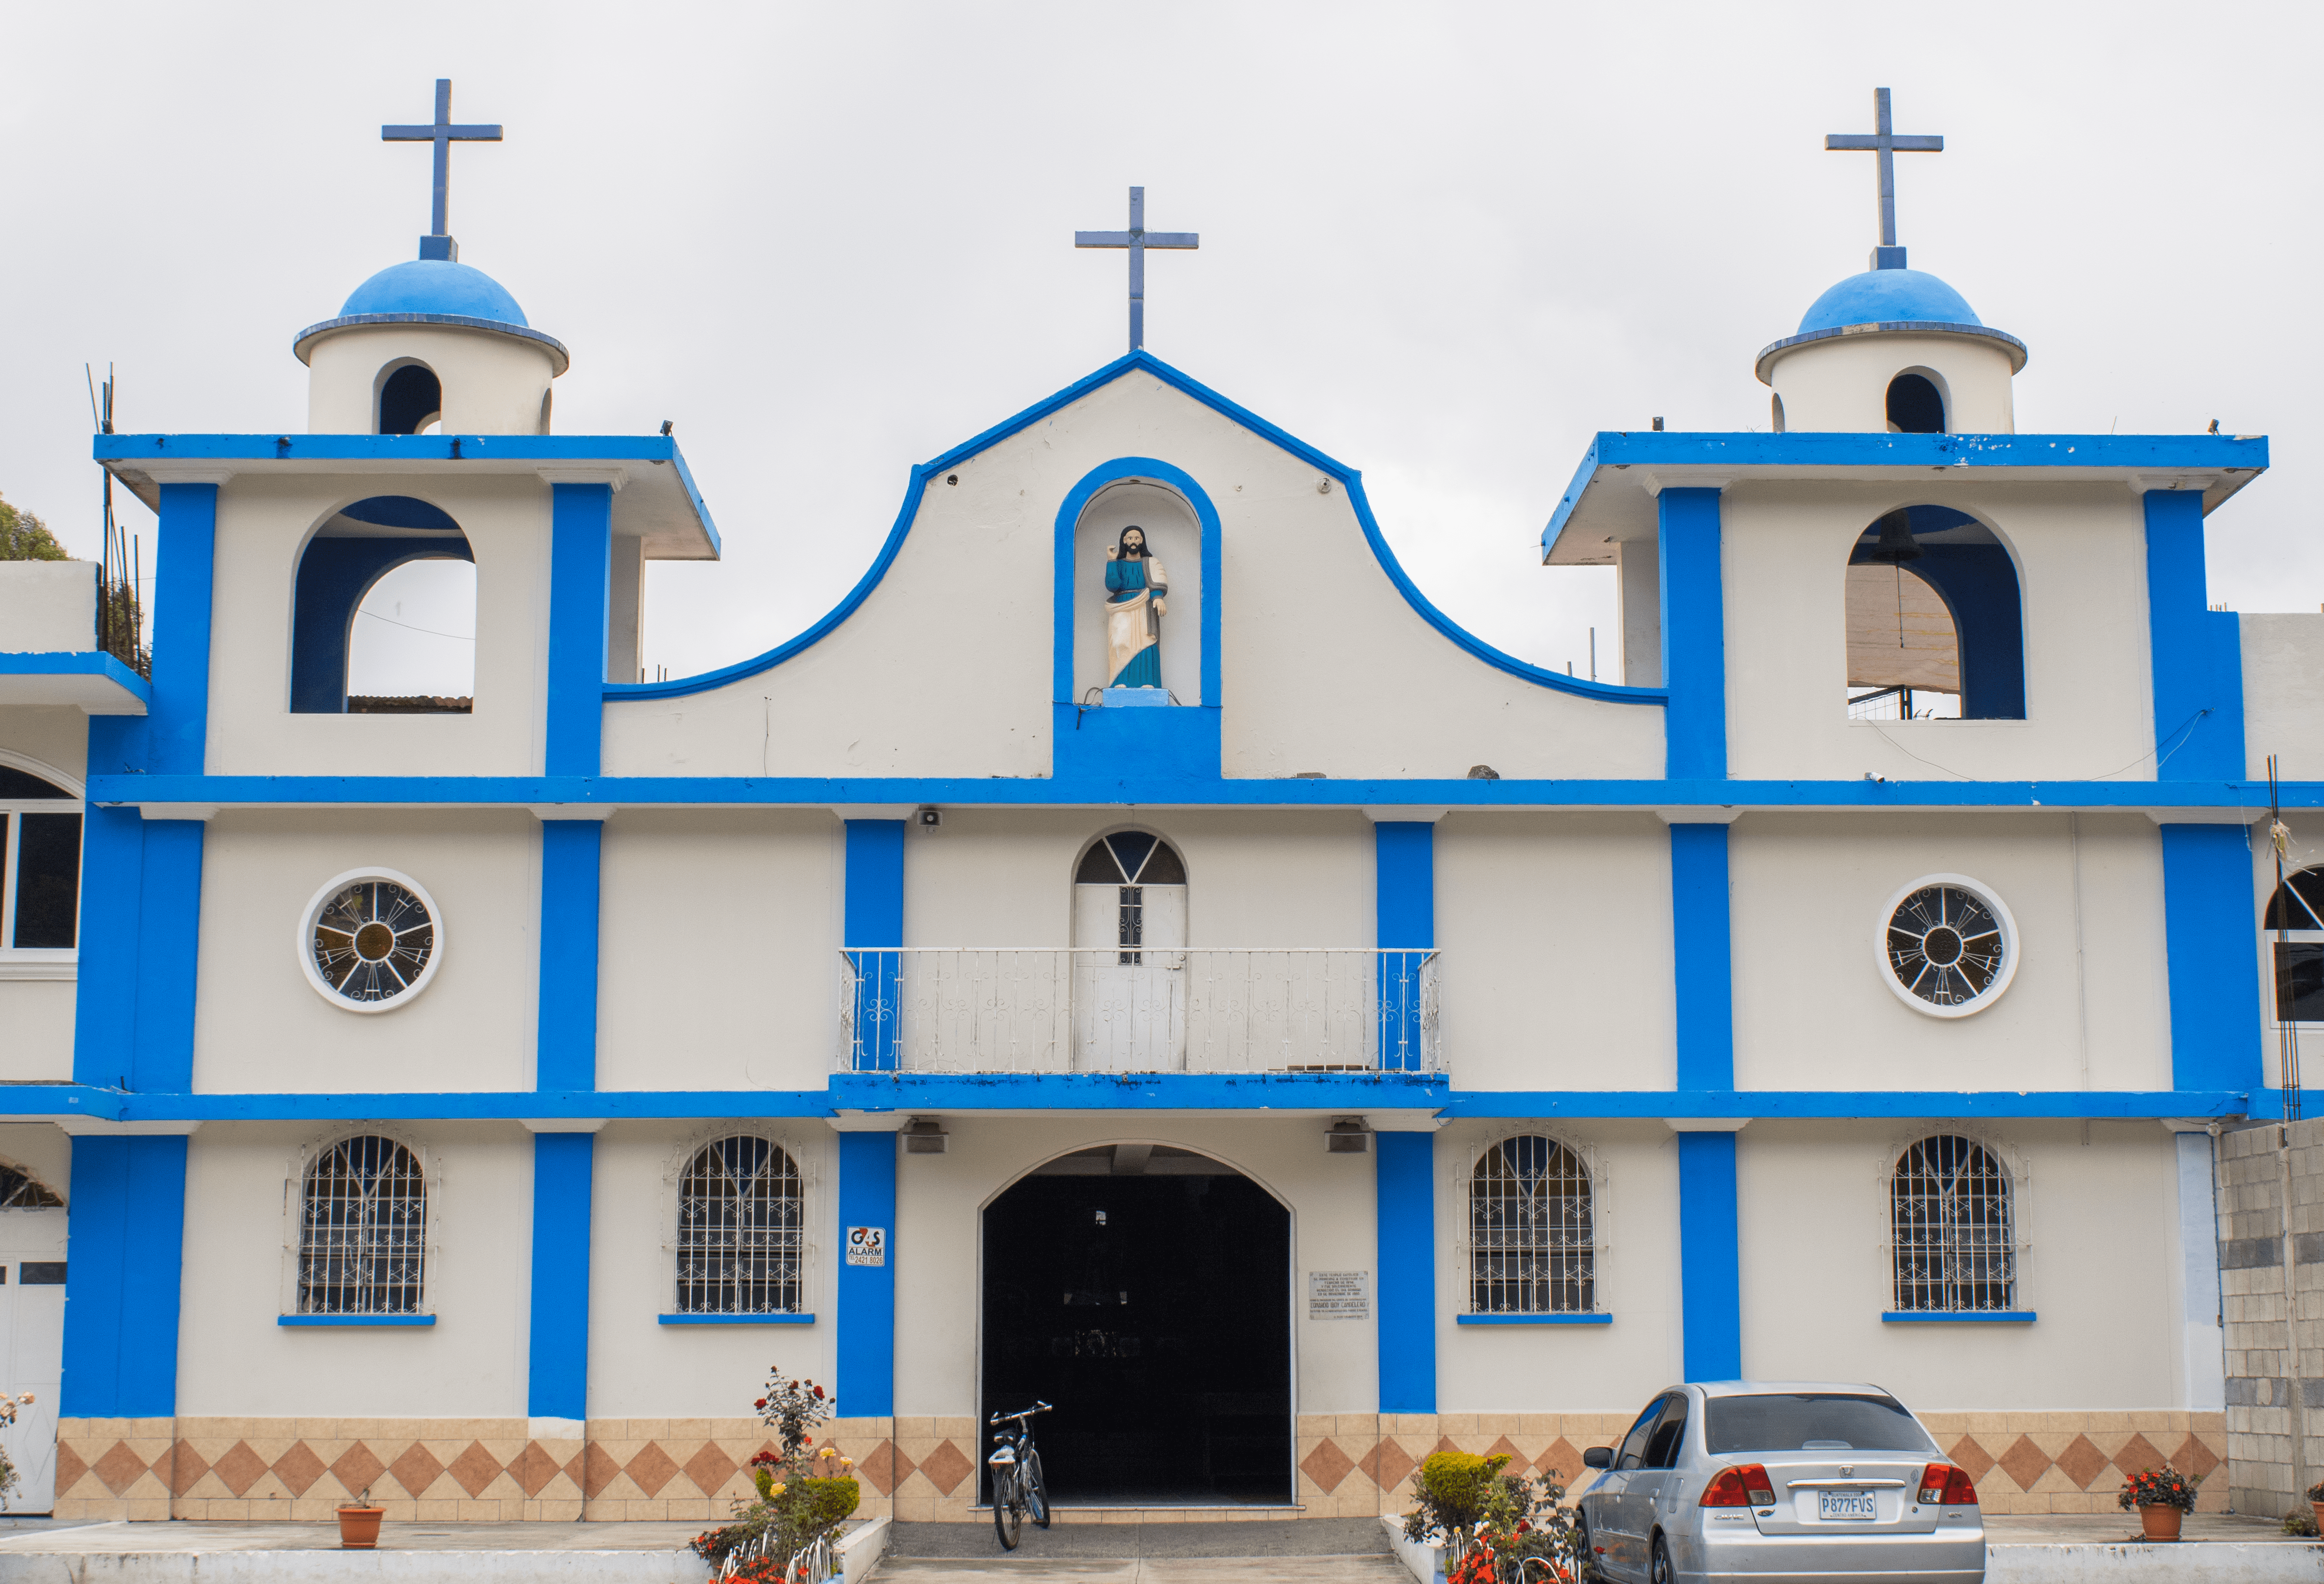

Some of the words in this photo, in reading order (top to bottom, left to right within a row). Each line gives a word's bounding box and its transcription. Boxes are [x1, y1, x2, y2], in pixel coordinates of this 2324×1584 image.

[851, 1228, 880, 1247] G4S
[849, 1247, 882, 1255] ALARM
[1822, 1497, 1873, 1512] P877FVS
